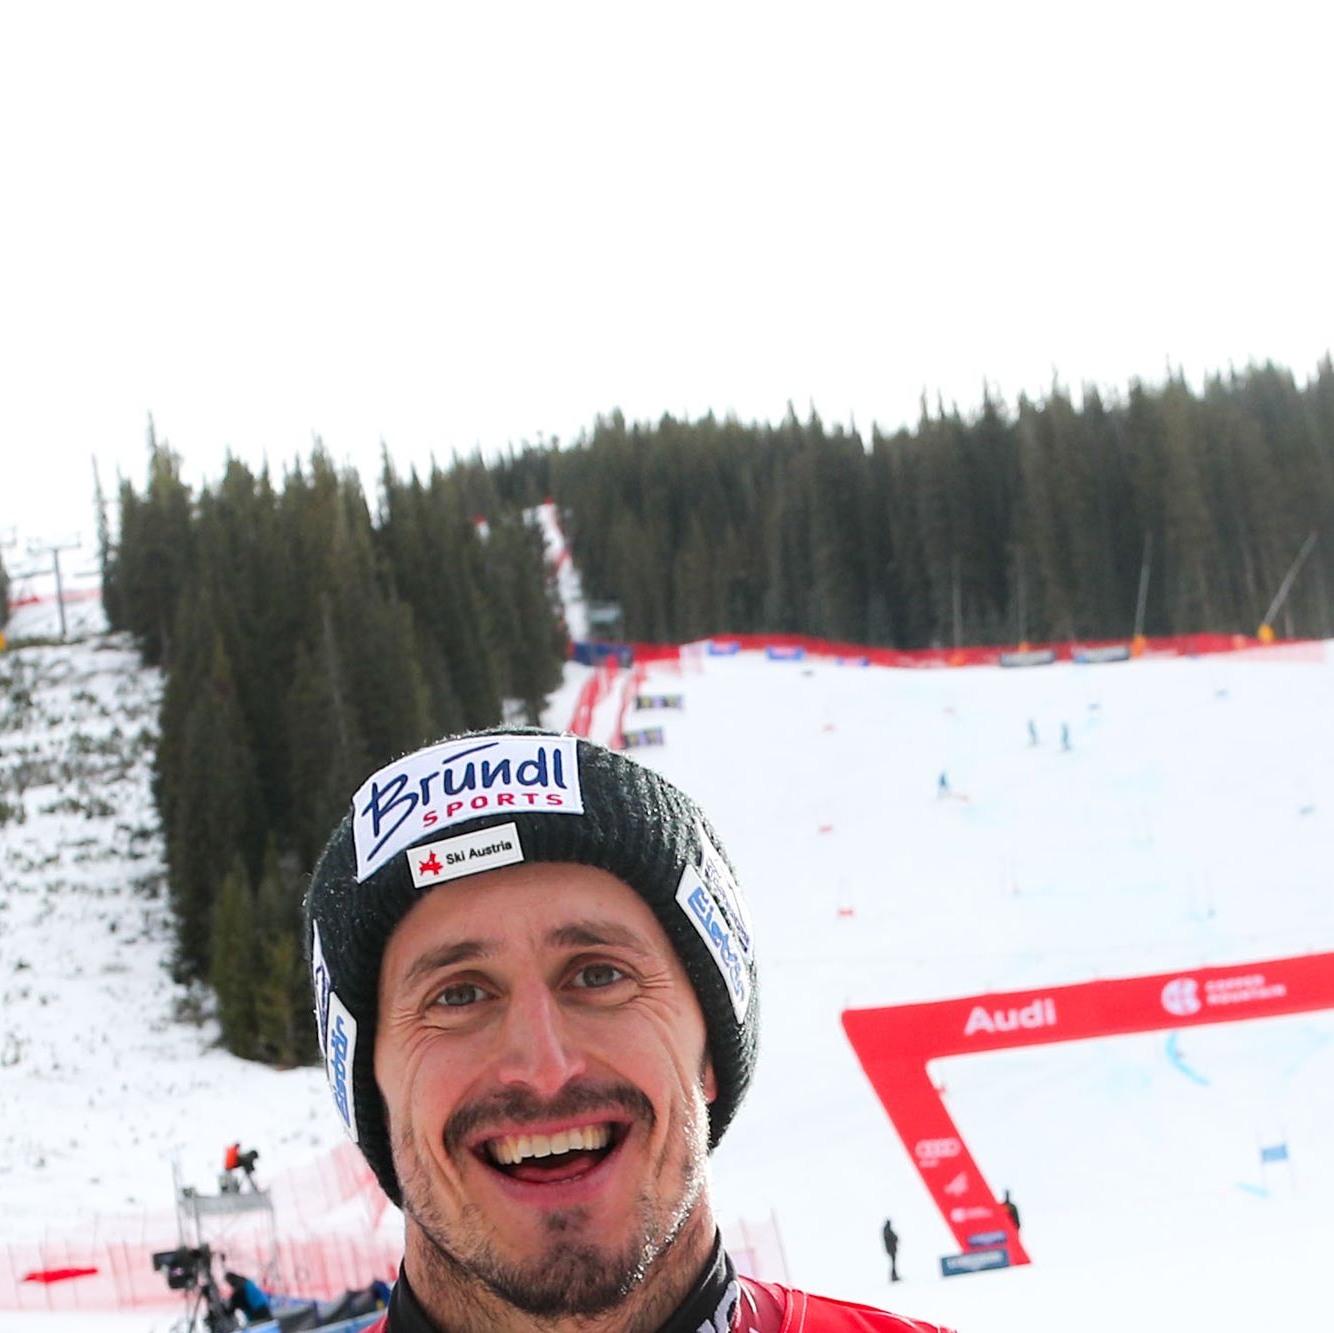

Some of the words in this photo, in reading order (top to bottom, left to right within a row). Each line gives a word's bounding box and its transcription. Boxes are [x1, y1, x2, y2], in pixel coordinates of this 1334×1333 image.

[423, 793, 563, 827] SPORTS
[445, 851, 466, 866] Ski
[469, 839, 513, 860] Austria
[964, 997, 1057, 1036] Audi
